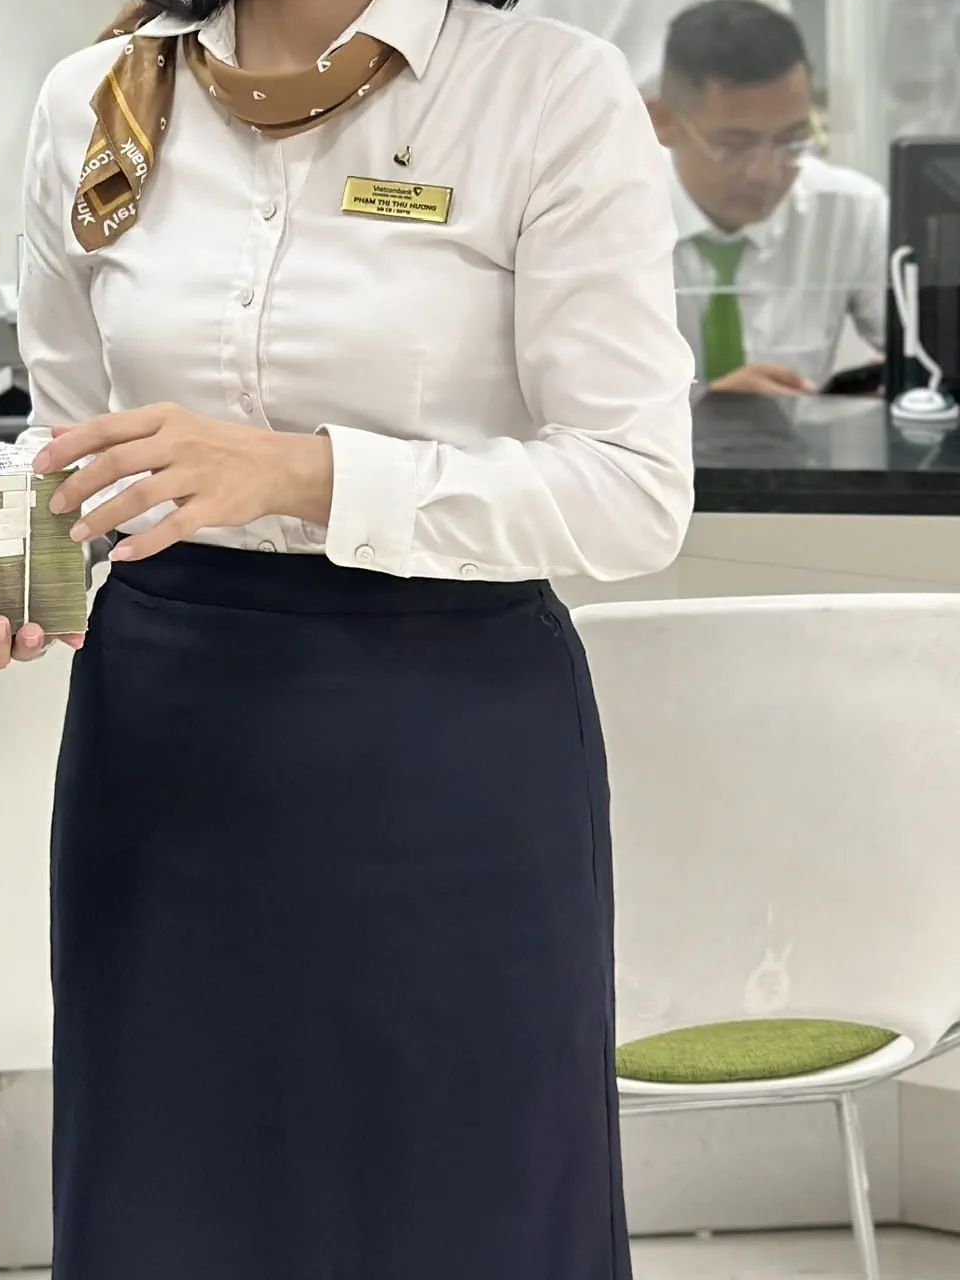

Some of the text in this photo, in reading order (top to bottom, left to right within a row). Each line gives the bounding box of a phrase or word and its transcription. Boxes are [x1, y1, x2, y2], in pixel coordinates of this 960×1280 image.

[373, 184, 412, 196] Vietcombank
[353, 196, 376, 206] PHẠM
[392, 200, 408, 209] THU
